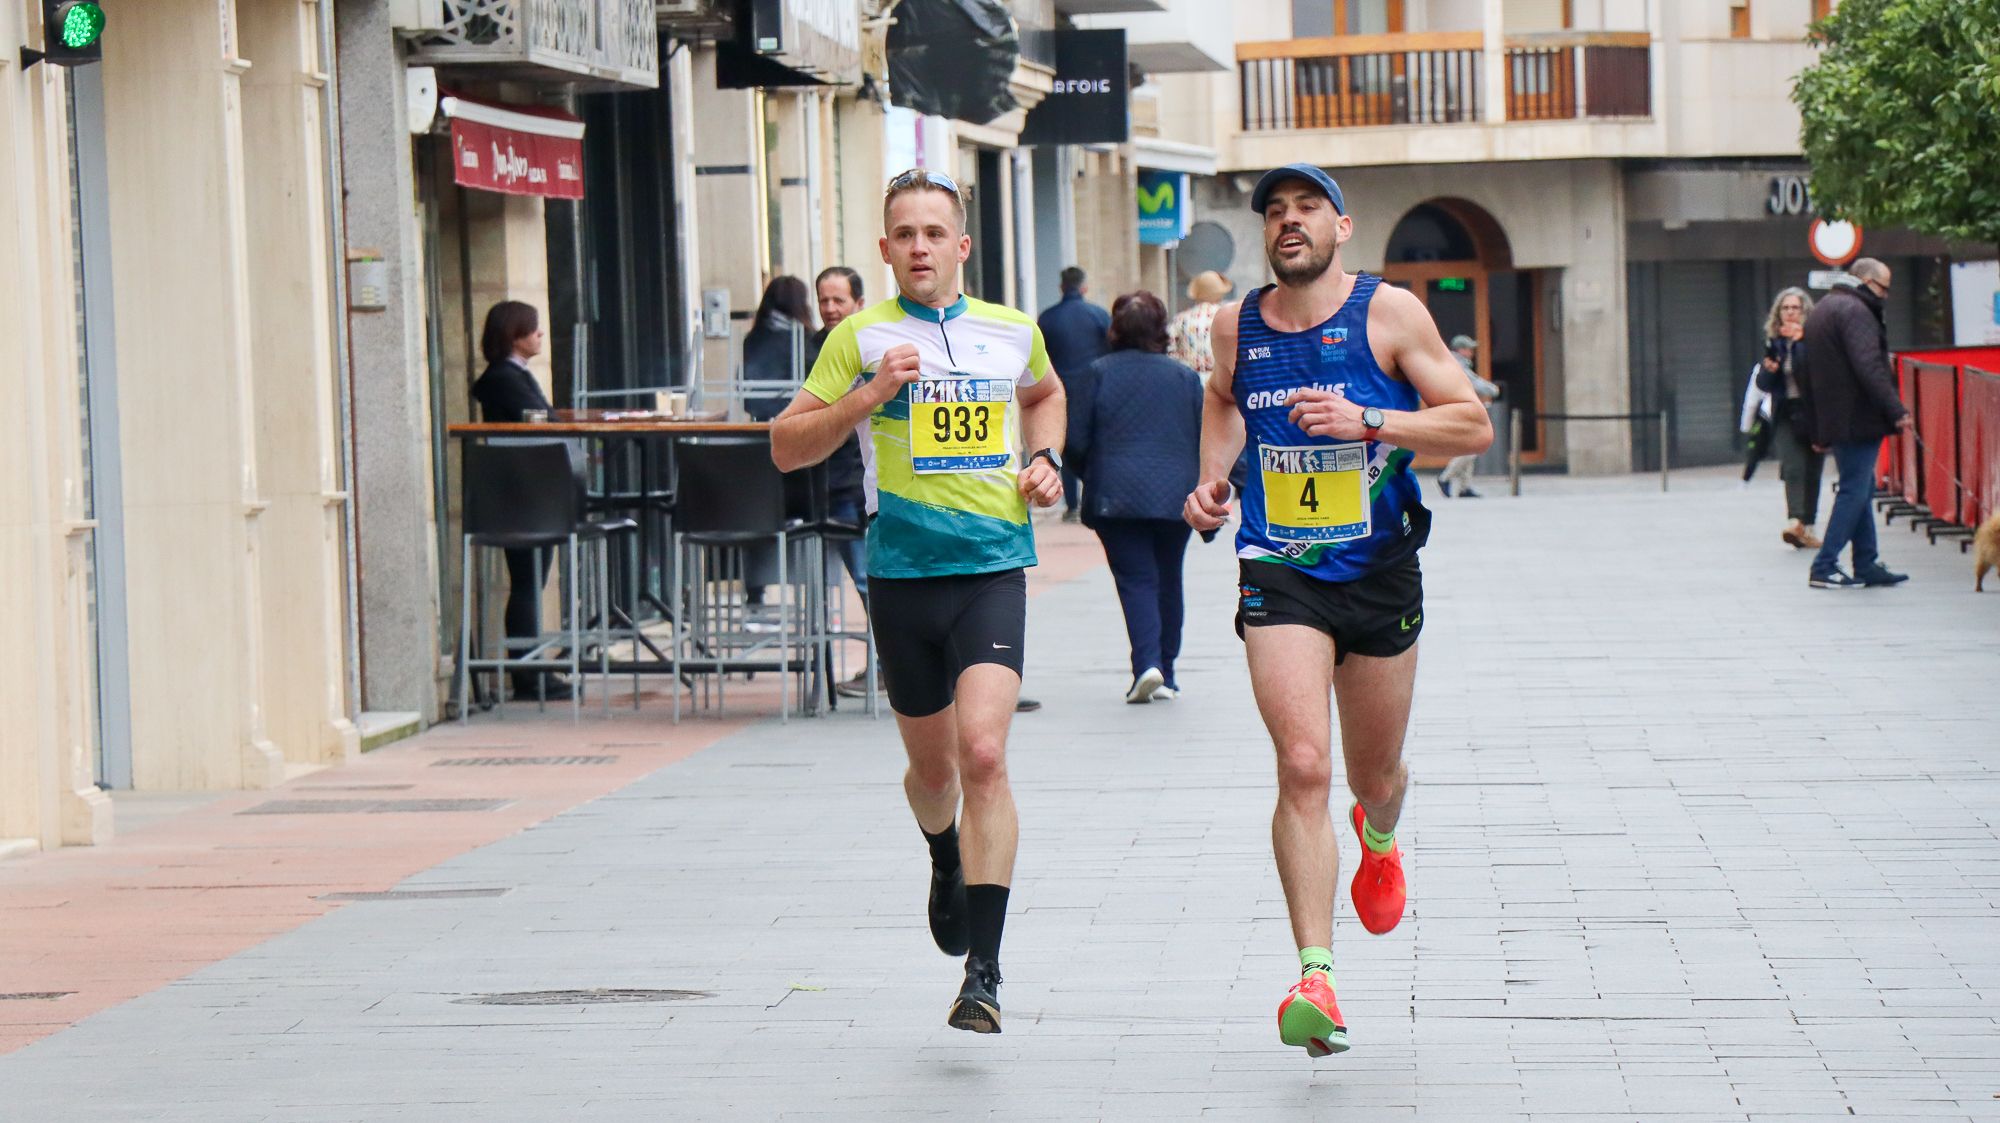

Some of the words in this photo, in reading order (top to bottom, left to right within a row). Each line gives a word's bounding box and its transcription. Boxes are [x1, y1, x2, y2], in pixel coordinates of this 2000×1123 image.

[1053, 79, 1111, 94] RFOIS
[924, 381, 958, 403] 21K
[933, 406, 989, 443] 933
[1271, 452, 1303, 474] 21K
[1299, 477, 1319, 513] 4
